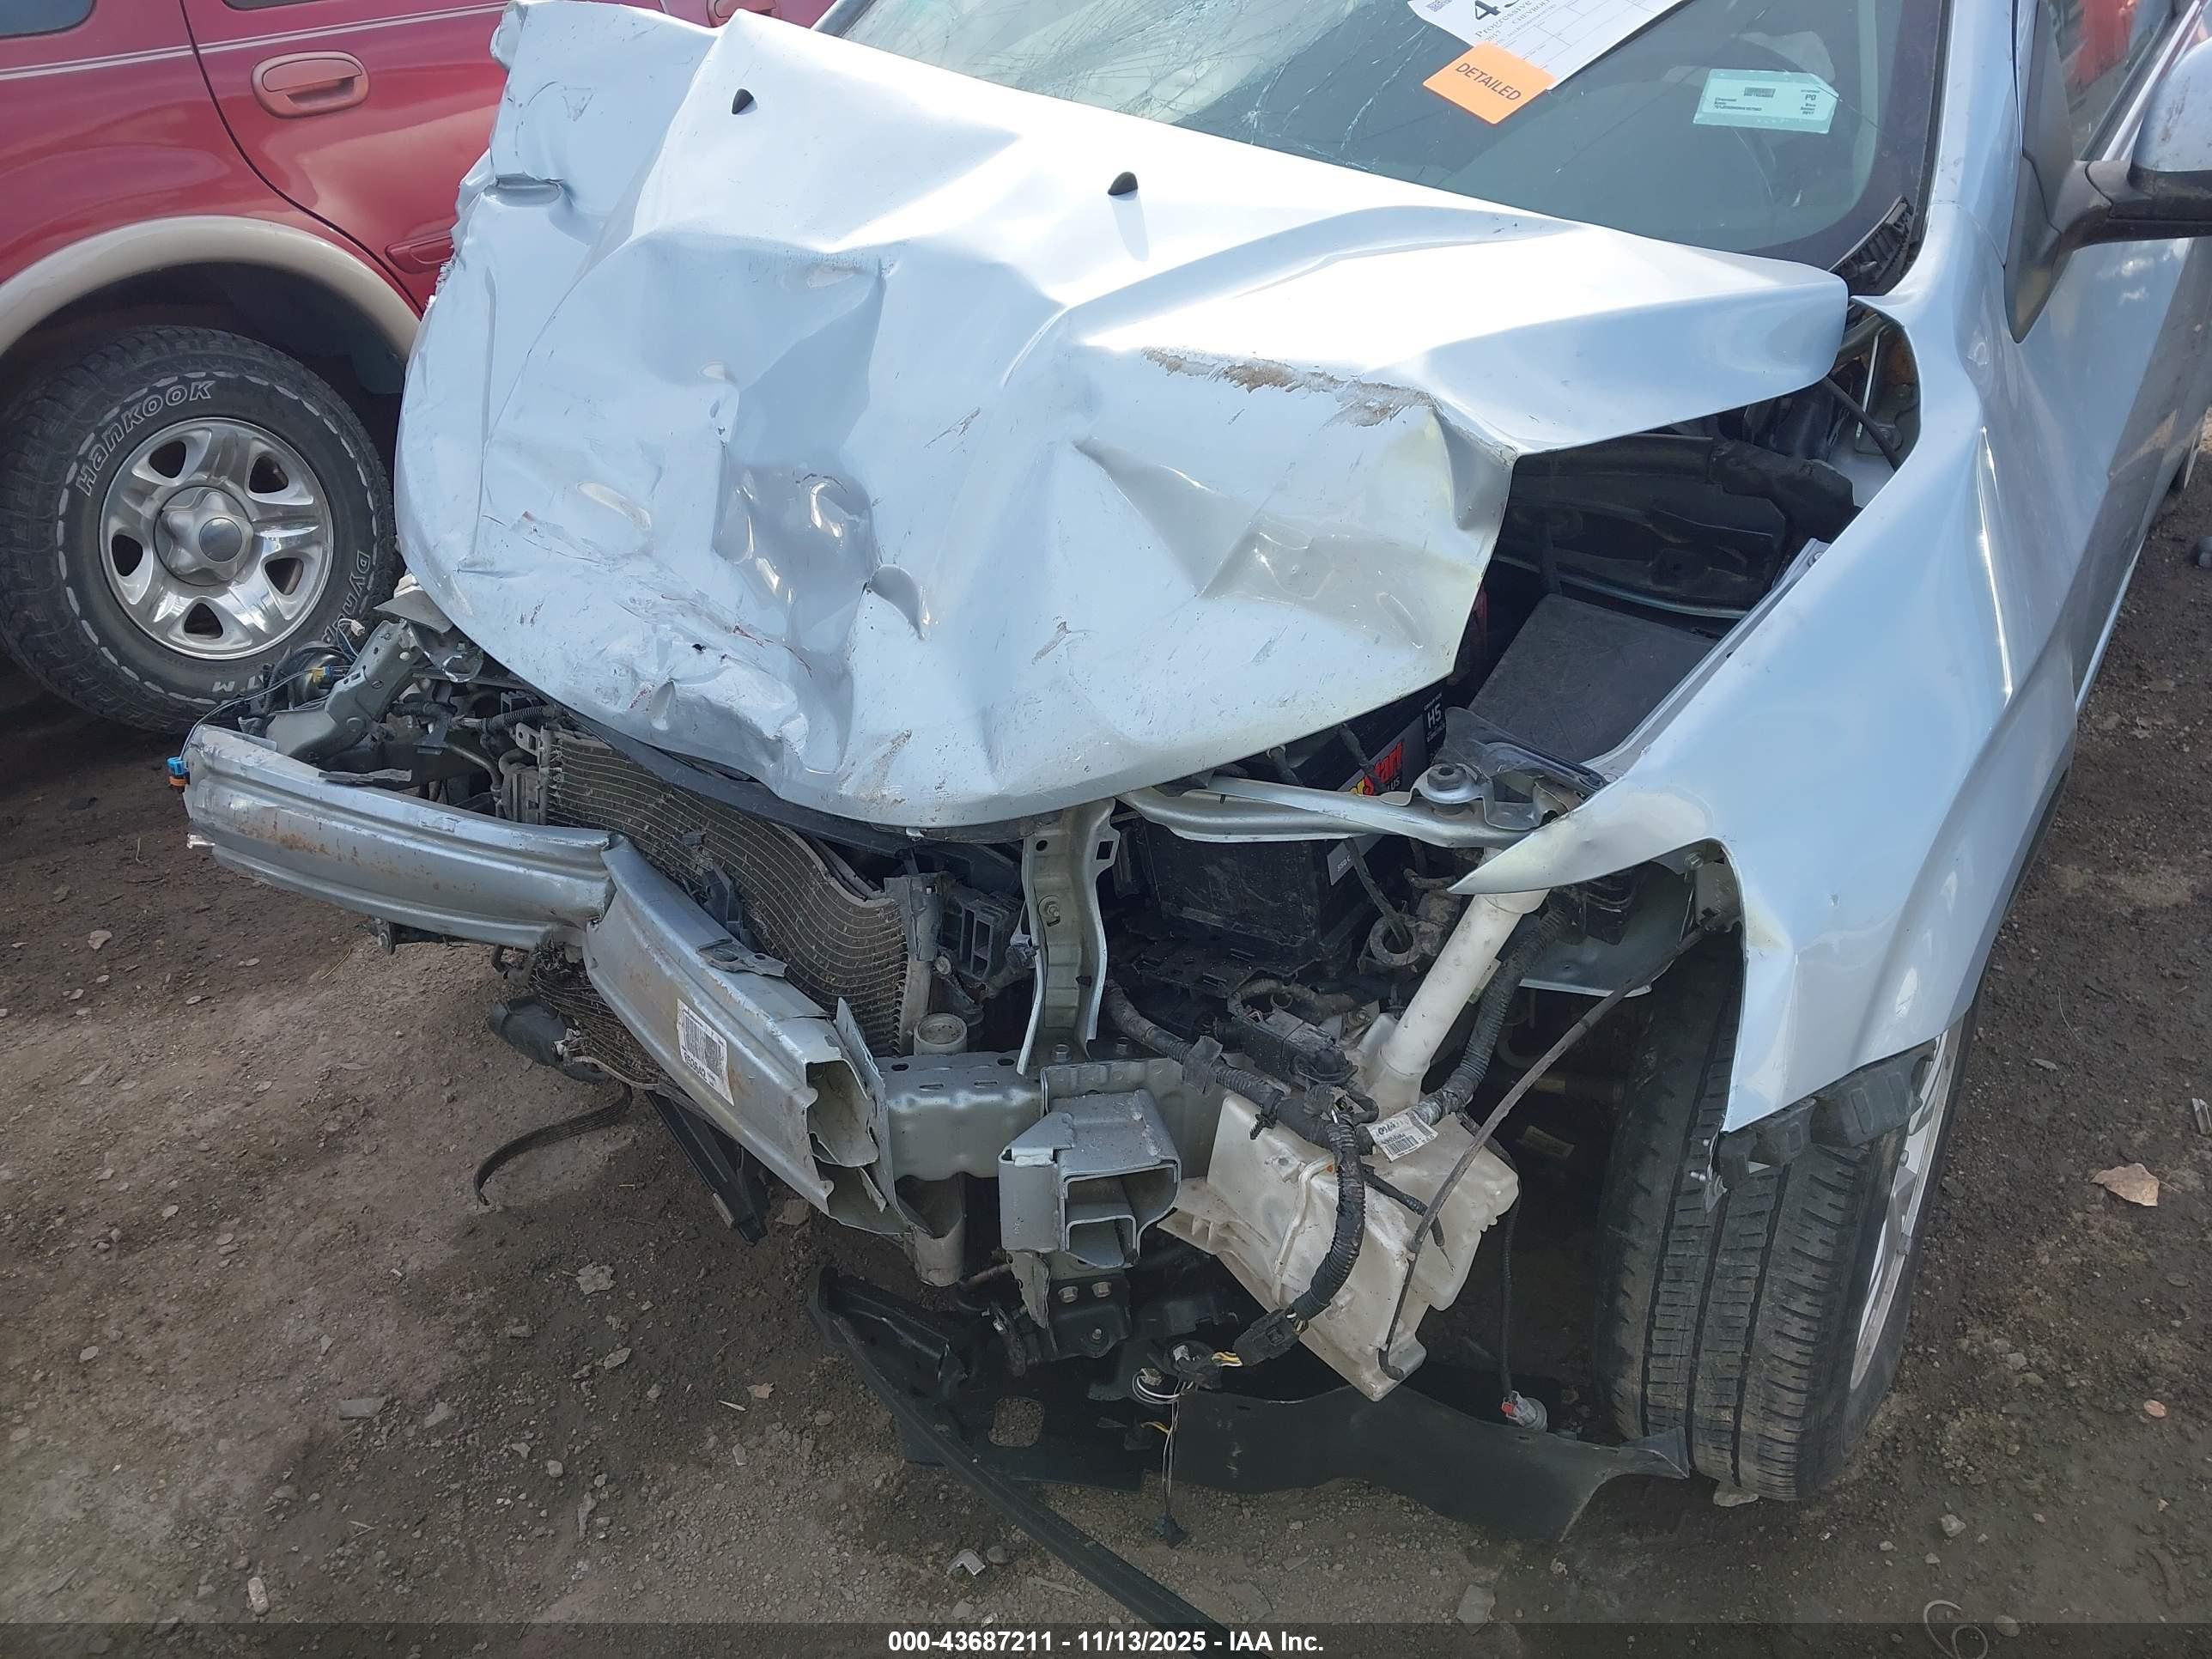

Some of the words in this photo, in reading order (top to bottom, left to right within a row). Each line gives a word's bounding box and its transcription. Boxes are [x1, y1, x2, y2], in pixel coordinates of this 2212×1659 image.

[1474, 0, 1533, 38] Progressive
[1455, 63, 1522, 100] DETAILED
[1427, 703, 1442, 728] H5
